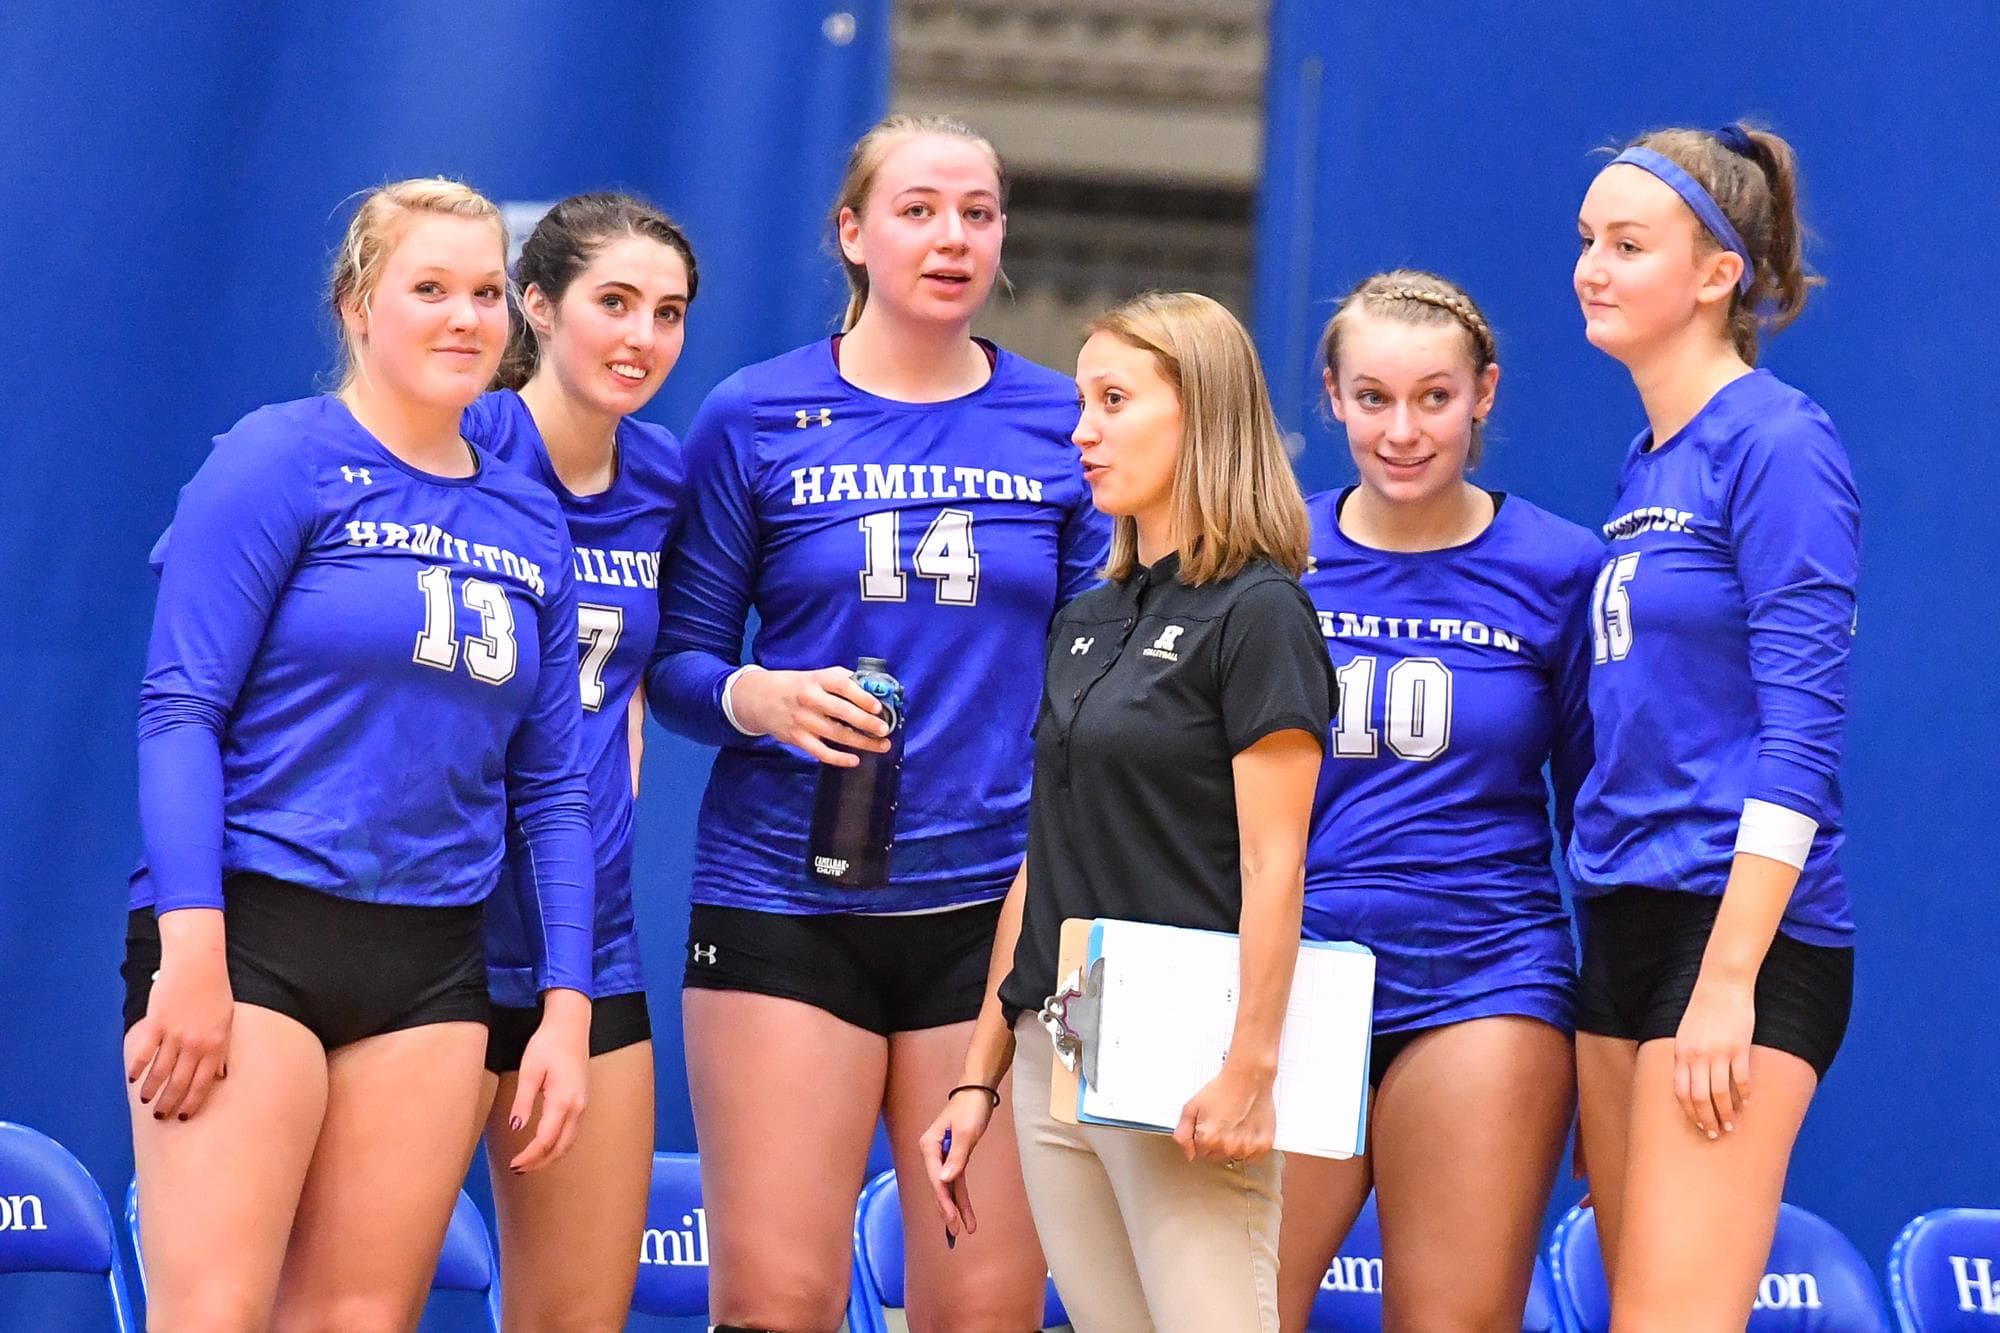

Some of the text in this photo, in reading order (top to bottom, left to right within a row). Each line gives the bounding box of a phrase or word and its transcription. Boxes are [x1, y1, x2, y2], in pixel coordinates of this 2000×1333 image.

[791, 464, 1043, 506] HAMILTON
[859, 507, 980, 607] 14
[1592, 551, 1641, 665] 15
[412, 565, 517, 686] 13
[577, 602, 624, 713] 7
[1331, 655, 1453, 762] 10
[1753, 1272, 1823, 1311] on
